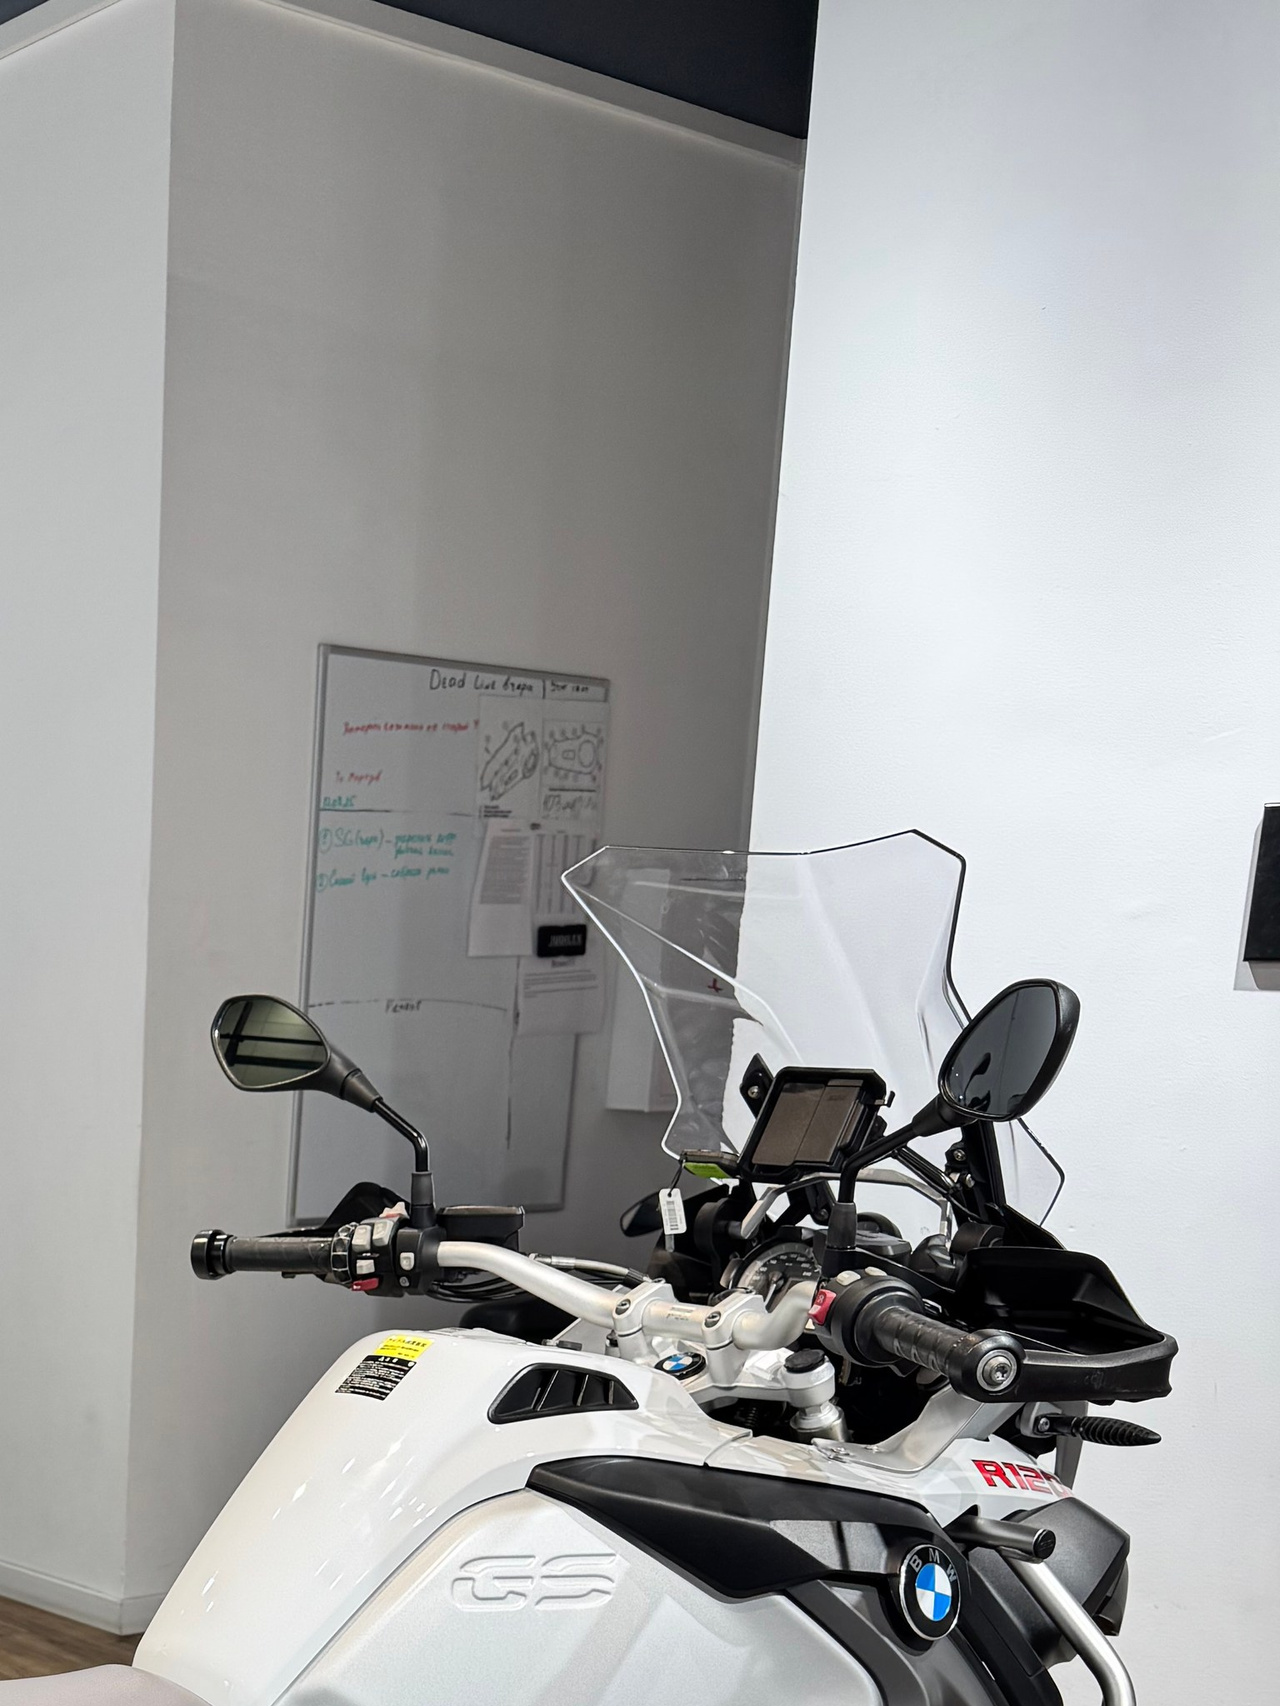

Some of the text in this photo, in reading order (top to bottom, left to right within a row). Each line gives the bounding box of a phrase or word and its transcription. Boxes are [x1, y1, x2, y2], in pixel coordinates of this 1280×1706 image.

[429, 668, 467, 691] Dead
[450, 1552, 617, 1611] GS
[909, 1548, 957, 1582] BMW
